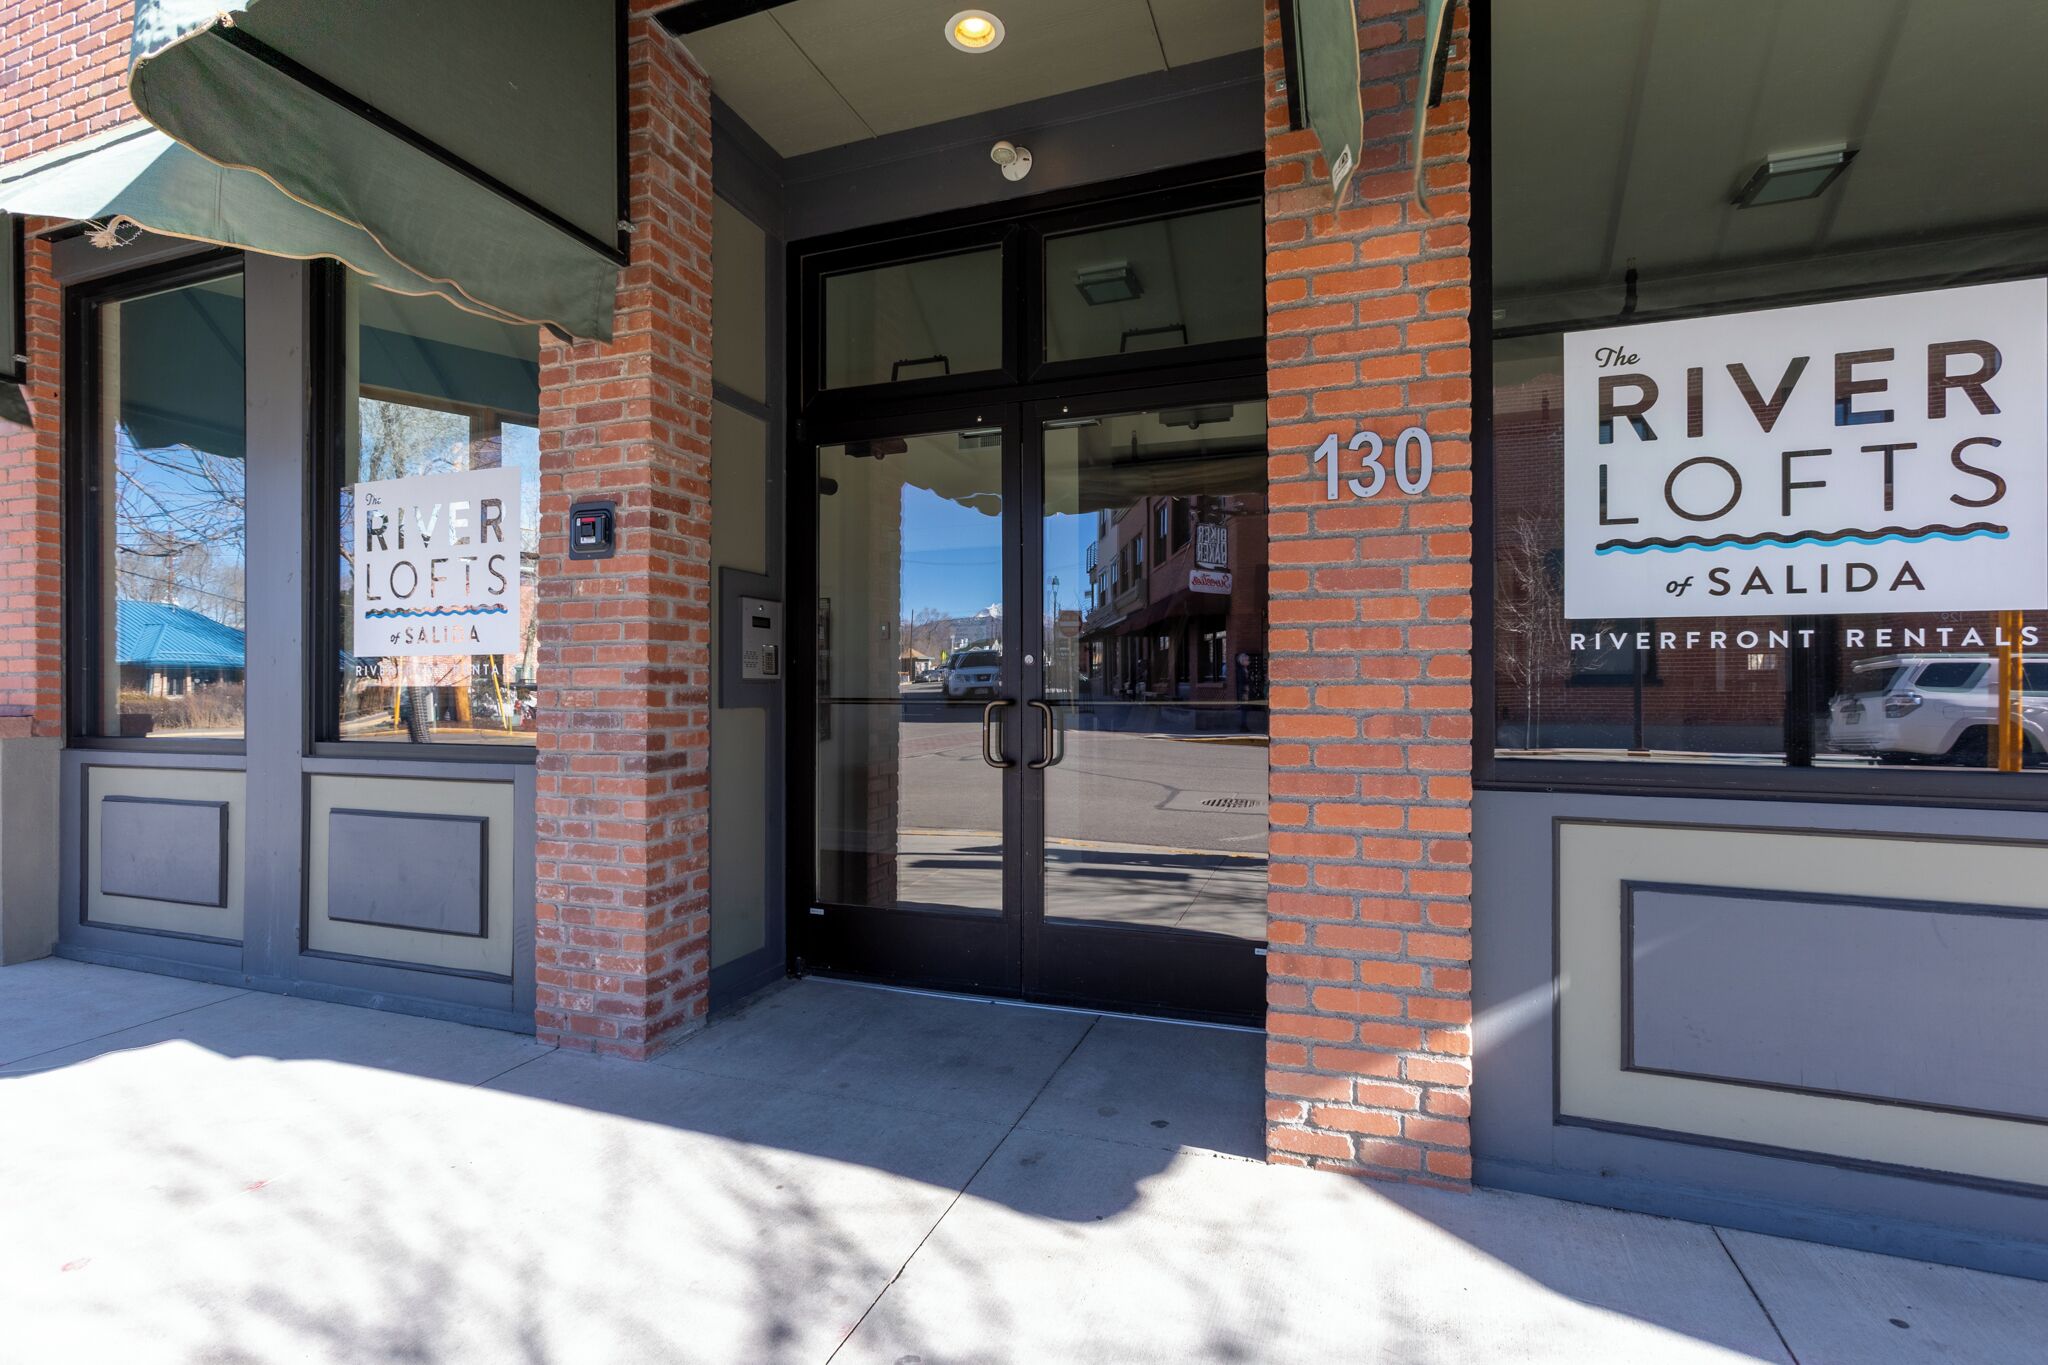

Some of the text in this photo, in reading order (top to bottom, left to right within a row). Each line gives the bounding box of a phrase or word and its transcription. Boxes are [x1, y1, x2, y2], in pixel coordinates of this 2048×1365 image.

[1595, 346, 1641, 368] The
[1598, 339, 2003, 445] RIVER
[1314, 427, 1433, 500] 130
[1598, 436, 2007, 526] LOFTS
[365, 493, 382, 506] The
[366, 498, 507, 552] RIVER
[366, 554, 508, 601] LOFTS
[1666, 560, 1926, 597] of SALIDA
[390, 625, 480, 645] of SALIDA
[1570, 626, 2039, 650] RIVERFRONT RENTALS
